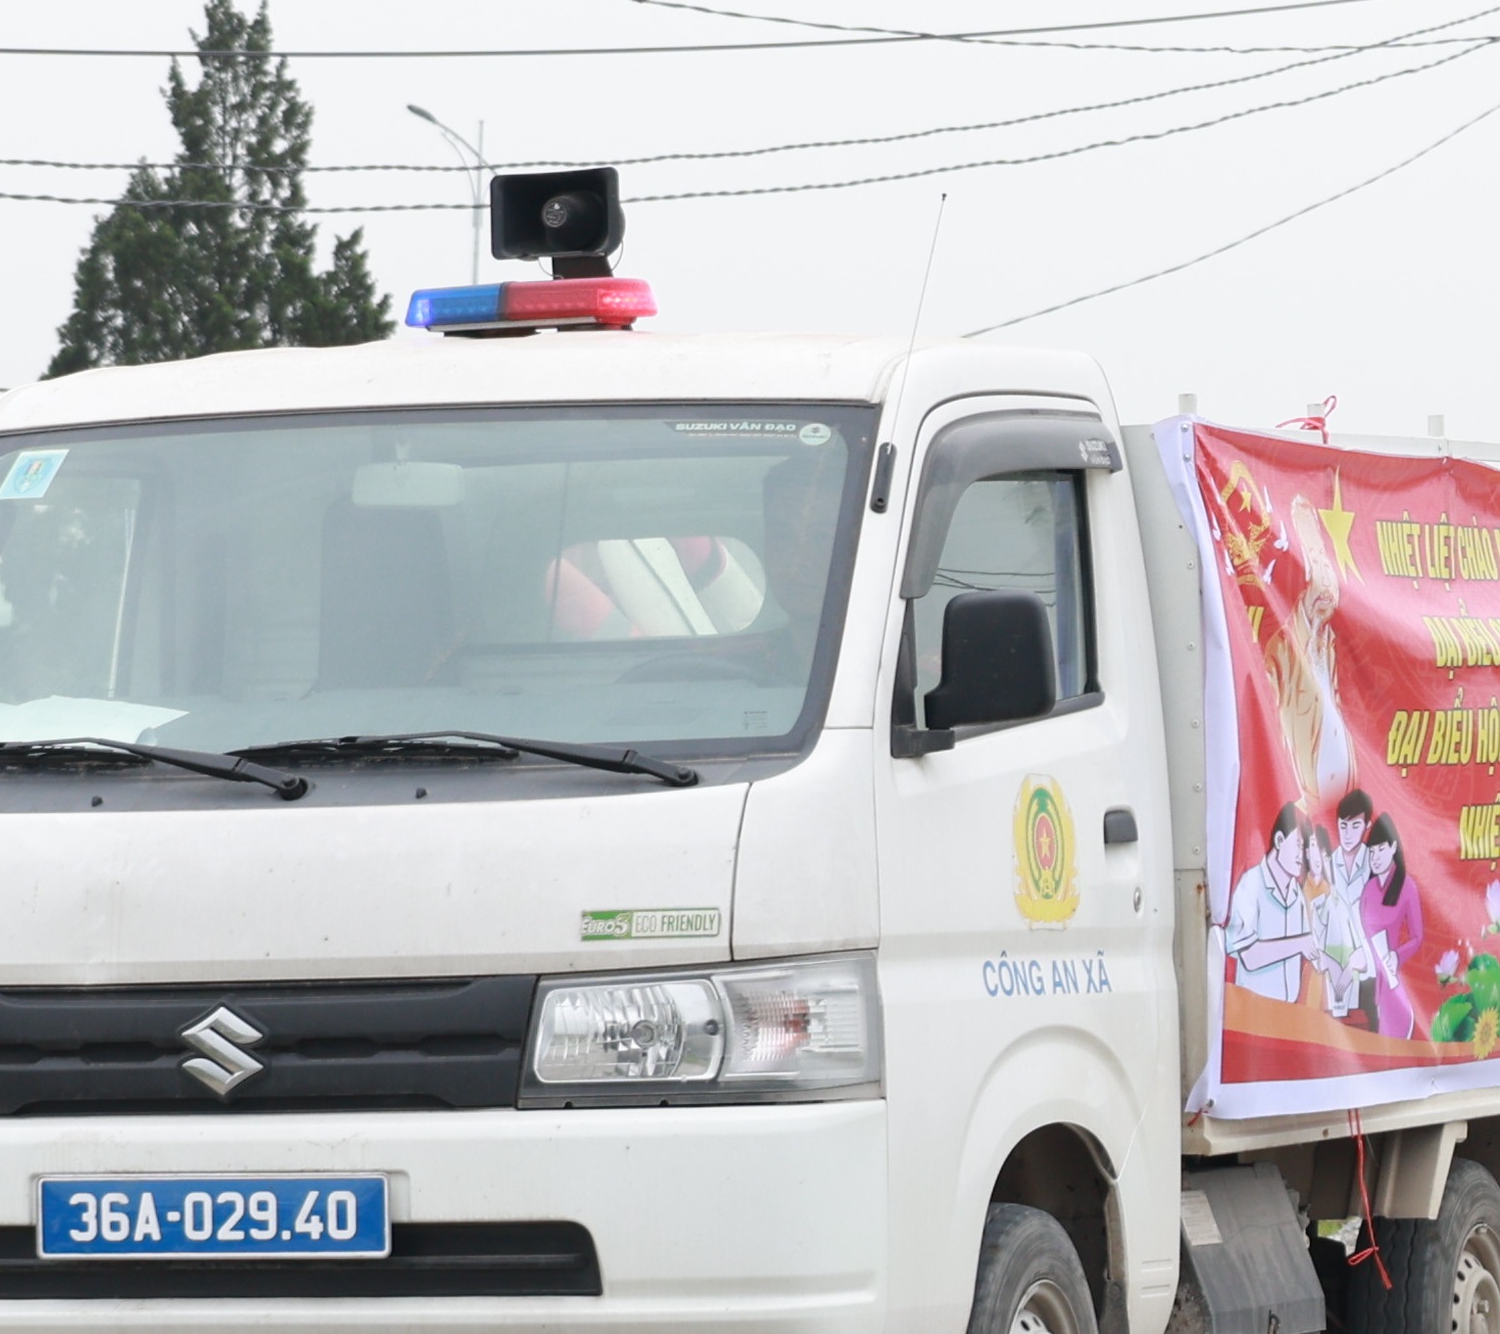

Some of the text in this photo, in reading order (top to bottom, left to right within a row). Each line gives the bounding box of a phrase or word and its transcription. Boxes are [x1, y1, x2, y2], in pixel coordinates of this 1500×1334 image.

[675, 422, 727, 432] SUZUKI
[1376, 509, 1424, 592] NHIỆT
[1424, 510, 1456, 593] LIỆT
[1456, 513, 1500, 582] CHÀO
[1386, 708, 1431, 779] ĐẠI
[1425, 685, 1475, 767] BIỂU
[635, 916, 657, 933] ECO
[658, 913, 717, 932] FRIENDLY
[982, 949, 1113, 998] CÔNG AN XÃ
[69, 1190, 358, 1242] 36A-029.40
